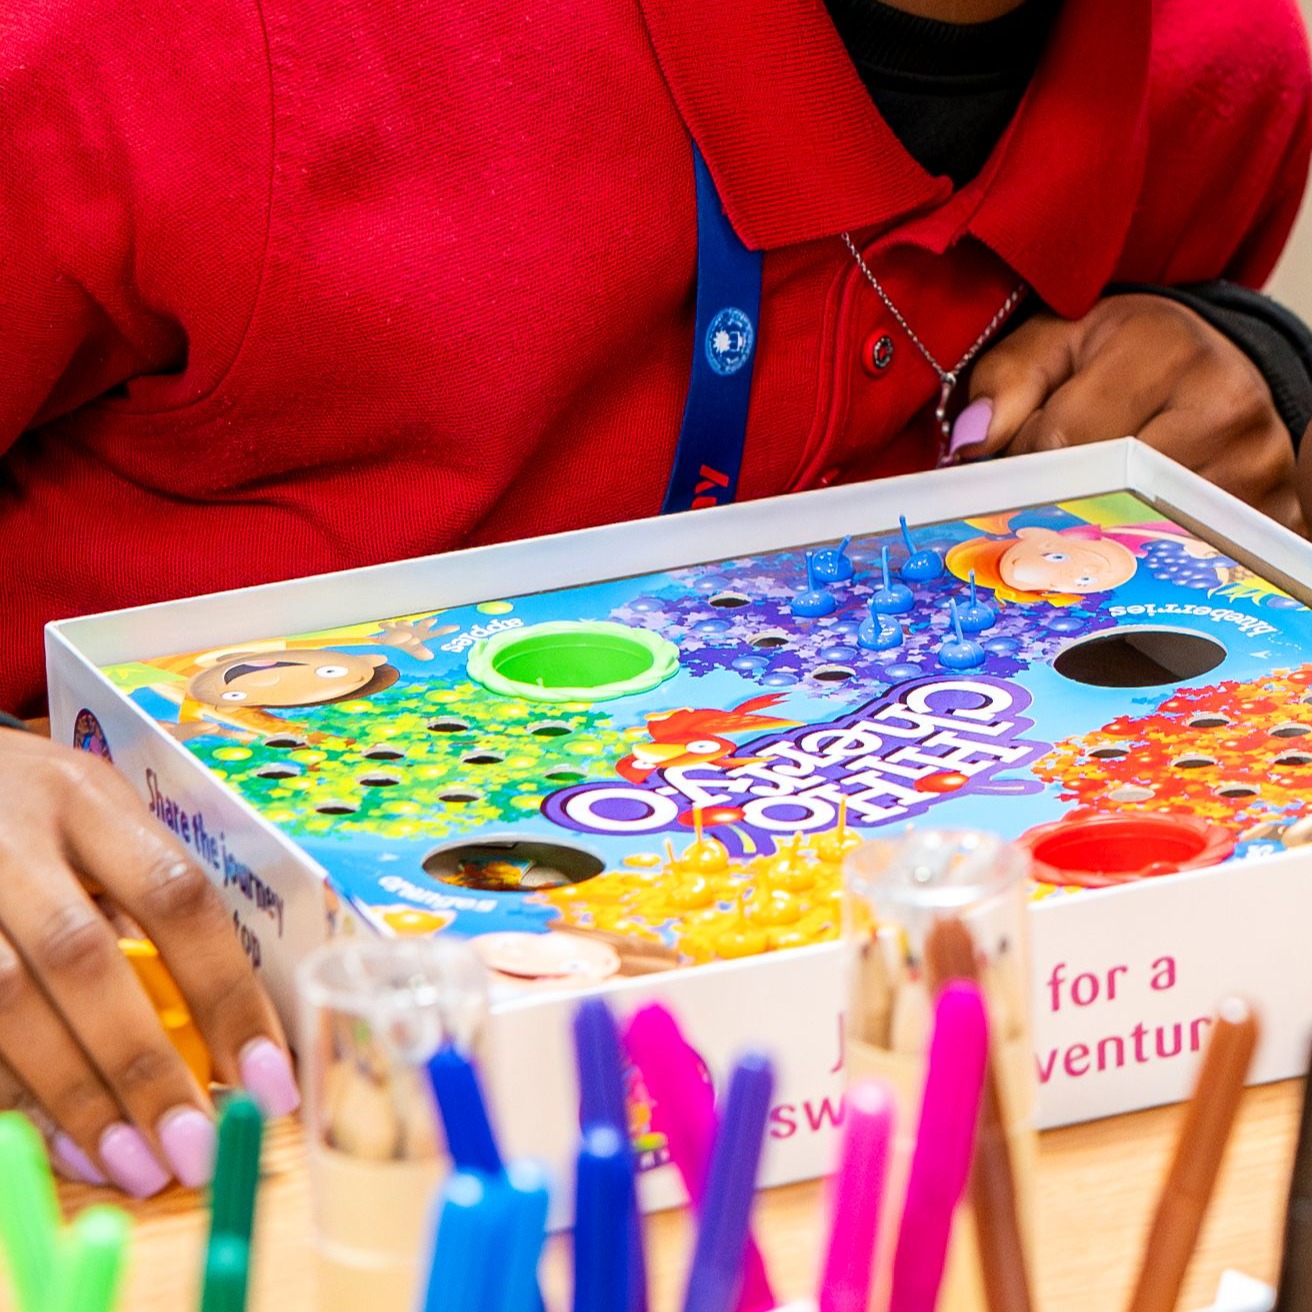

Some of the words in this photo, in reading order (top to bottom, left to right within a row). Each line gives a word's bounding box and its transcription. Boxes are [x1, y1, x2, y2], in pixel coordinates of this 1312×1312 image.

[440, 617, 525, 654] apples
[1108, 603, 1278, 638] blueberries
[145, 767, 191, 844] Share
[191, 811, 221, 870] the
[219, 831, 285, 939] journey
[1046, 961, 1128, 1013] for
[1148, 956, 1177, 991] a
[1034, 1014, 1212, 1085] ventur
